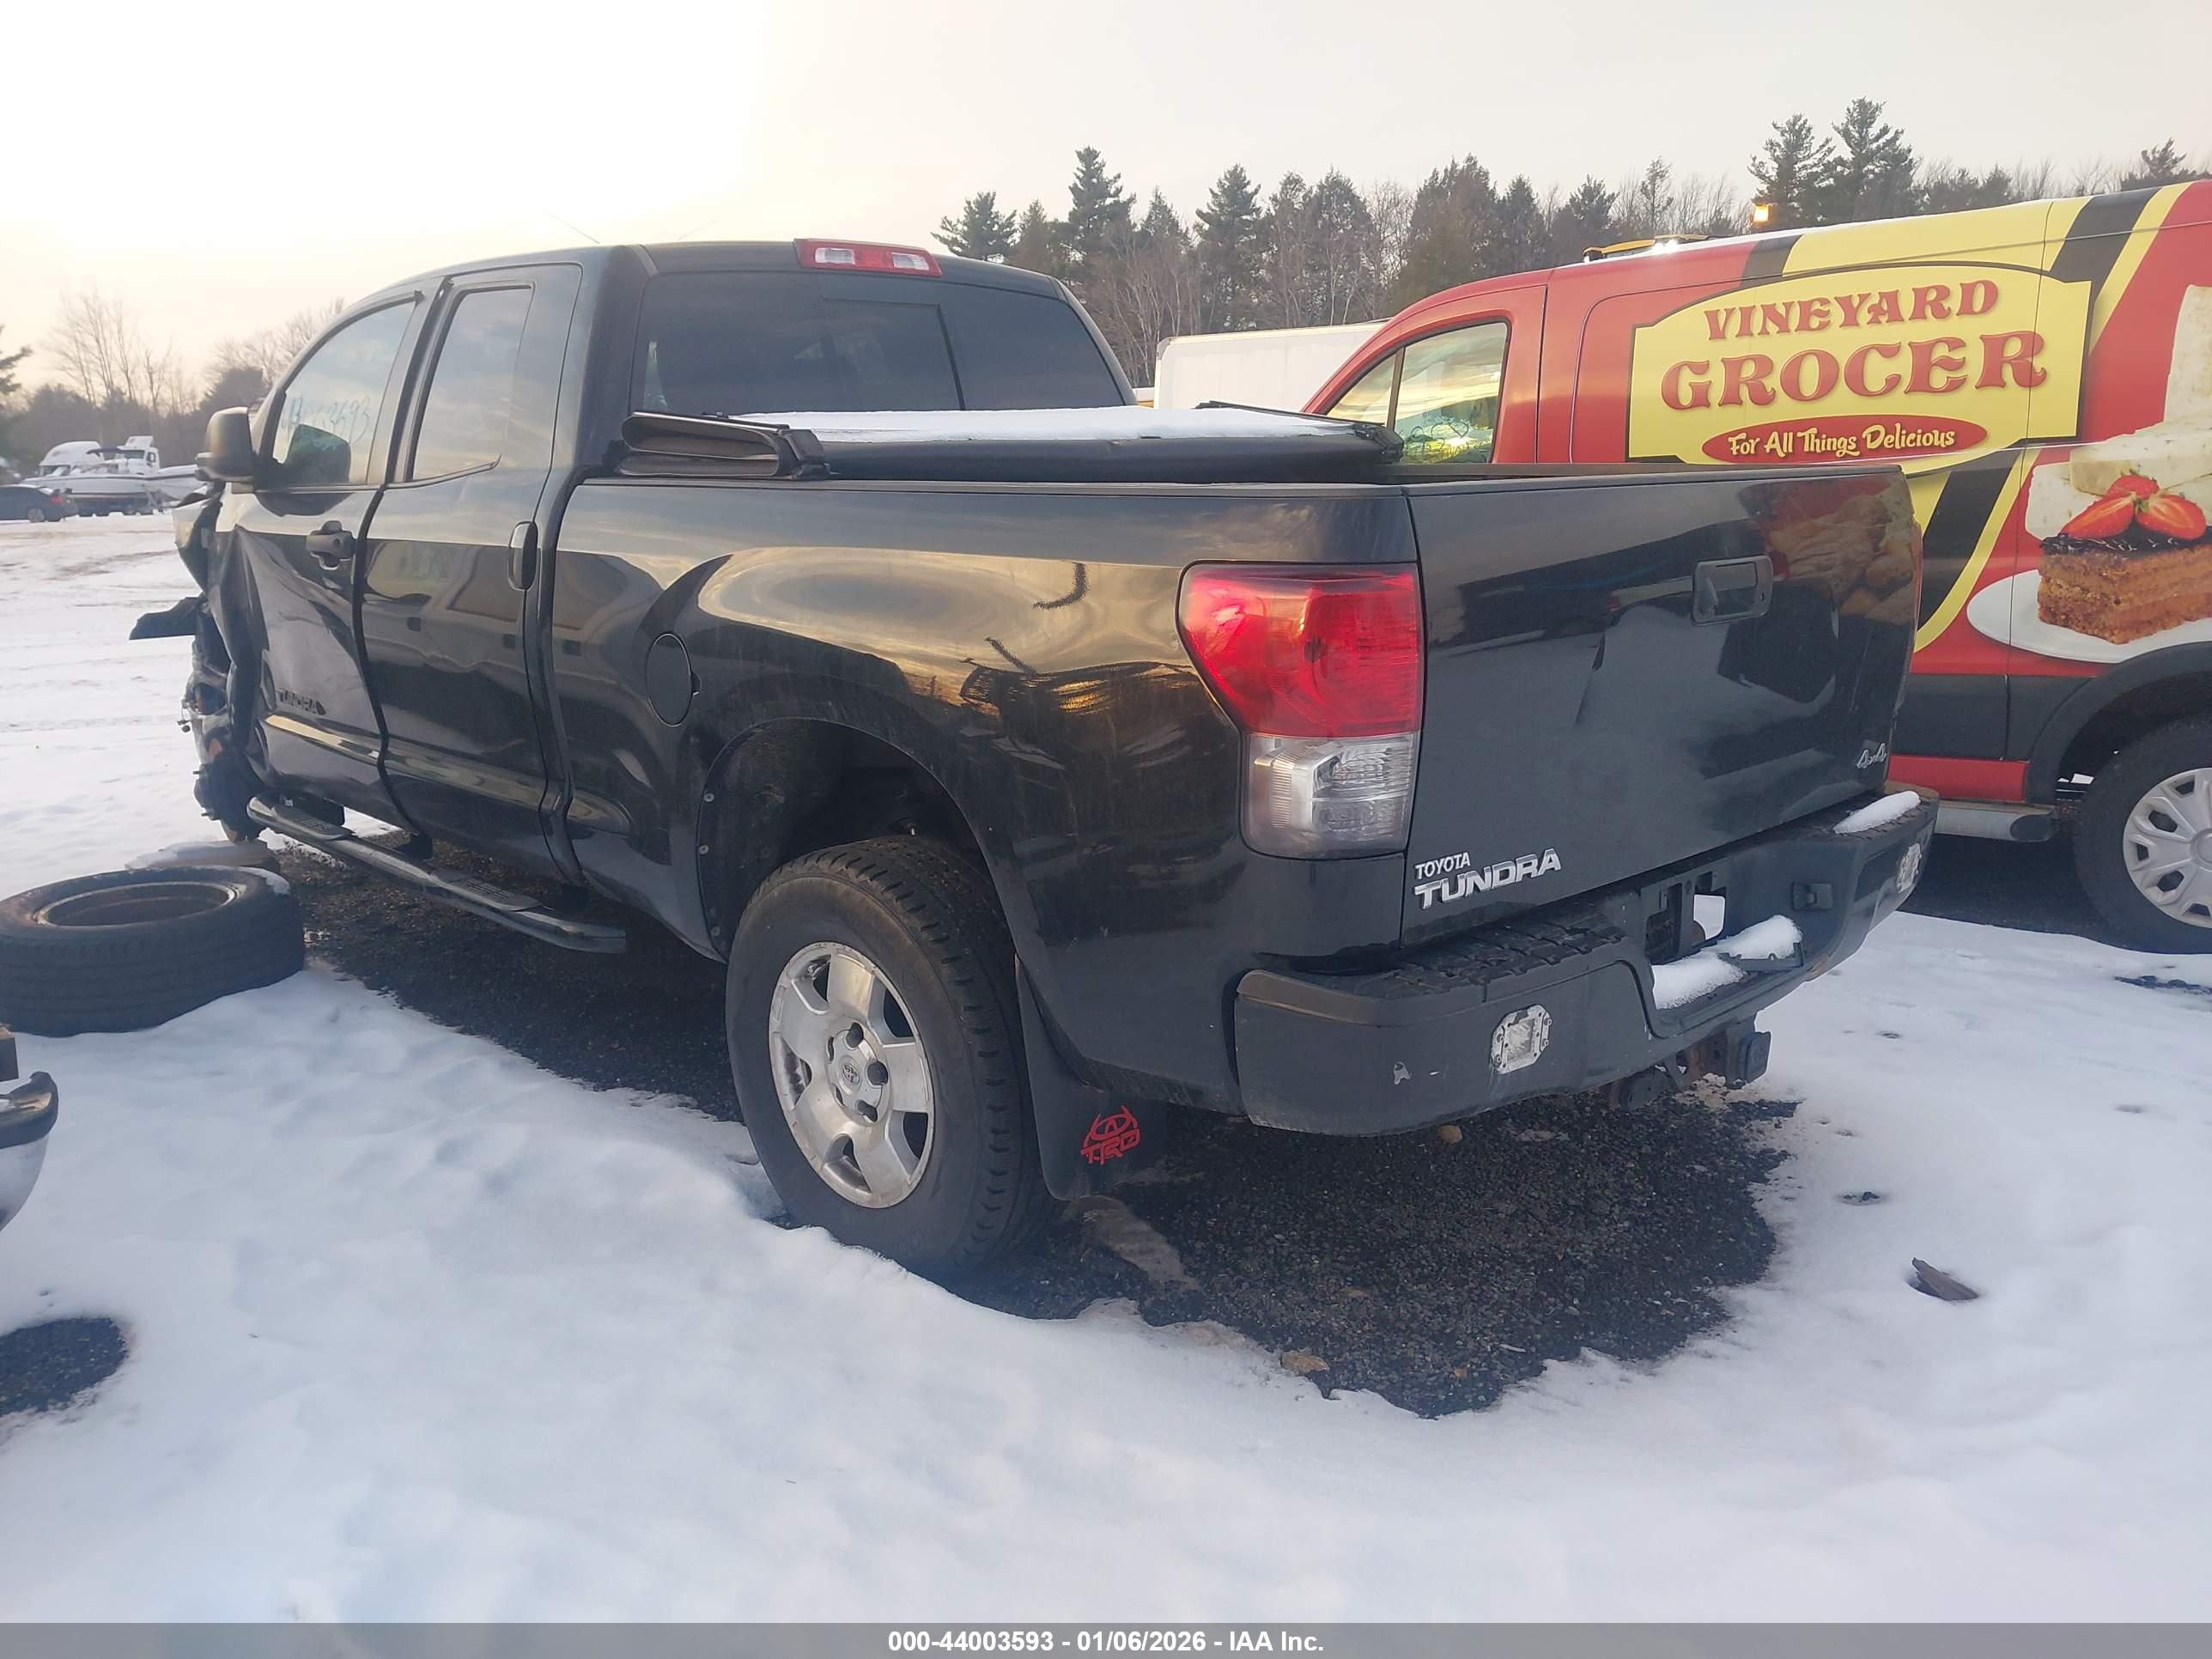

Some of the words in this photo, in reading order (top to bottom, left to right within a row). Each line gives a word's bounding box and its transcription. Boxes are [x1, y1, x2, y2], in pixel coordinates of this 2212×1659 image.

[1704, 279, 1999, 341] VINEYARD
[1662, 331, 2048, 410] GROCER
[1728, 433, 1759, 456] For
[1764, 431, 1794, 458] All
[1797, 428, 1861, 458] Things
[1862, 423, 1956, 450] Delicious
[1414, 852, 1471, 880] TOYOTA
[1414, 848, 1561, 910] TUNDRA
